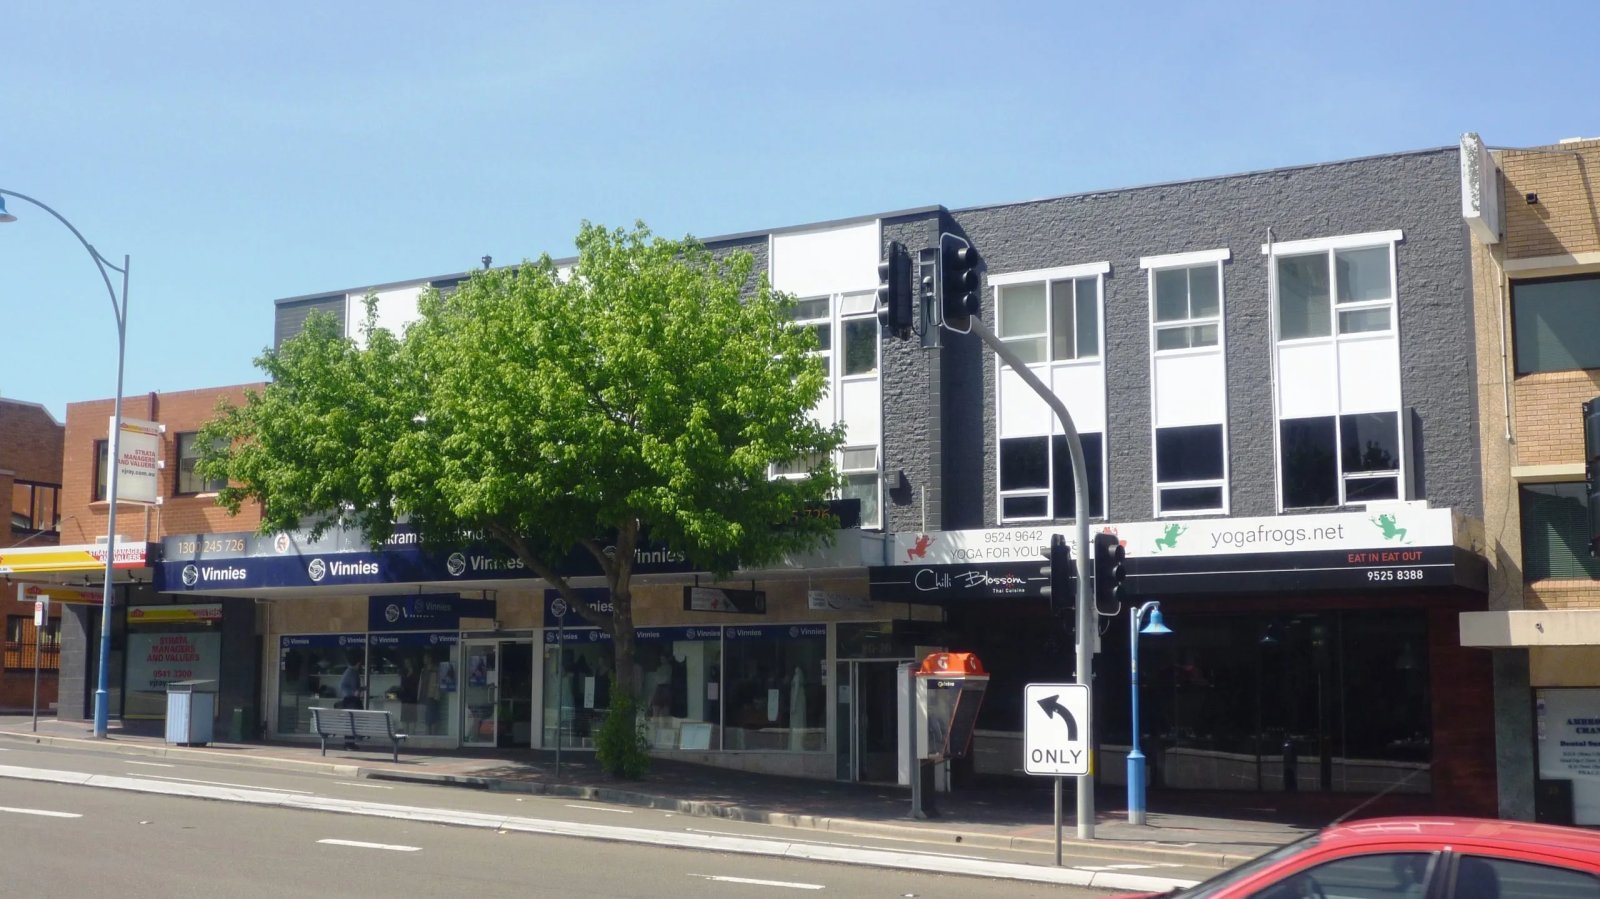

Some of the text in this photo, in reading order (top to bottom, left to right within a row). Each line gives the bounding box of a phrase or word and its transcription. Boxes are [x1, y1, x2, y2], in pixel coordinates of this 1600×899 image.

[123, 453, 156, 463] MANAGERS
[130, 460, 156, 469] VALUERS
[984, 530, 1043, 544] 9524 9642
[1211, 523, 1344, 548] yogafrogs.net
[203, 540, 222, 553] 245
[225, 539, 245, 552] 726
[633, 547, 686, 564] innies
[950, 548, 983, 560] YOGA
[986, 547, 1011, 559] FOR
[1347, 551, 1423, 563] EAT IN EAT OUT
[201, 566, 247, 580] Vinnies
[328, 560, 379, 576] Vinnies
[914, 568, 1027, 591] Chilli Blossom
[1367, 570, 1423, 581] 9525 8388
[636, 631, 660, 639] Vinnies
[736, 629, 762, 637] Vinnies
[800, 628, 827, 636] Vinnies
[290, 638, 310, 646] Vinnies
[347, 636, 366, 644] Vinnies
[378, 636, 399, 644] Vinnies
[1031, 748, 1082, 764] ONLY
